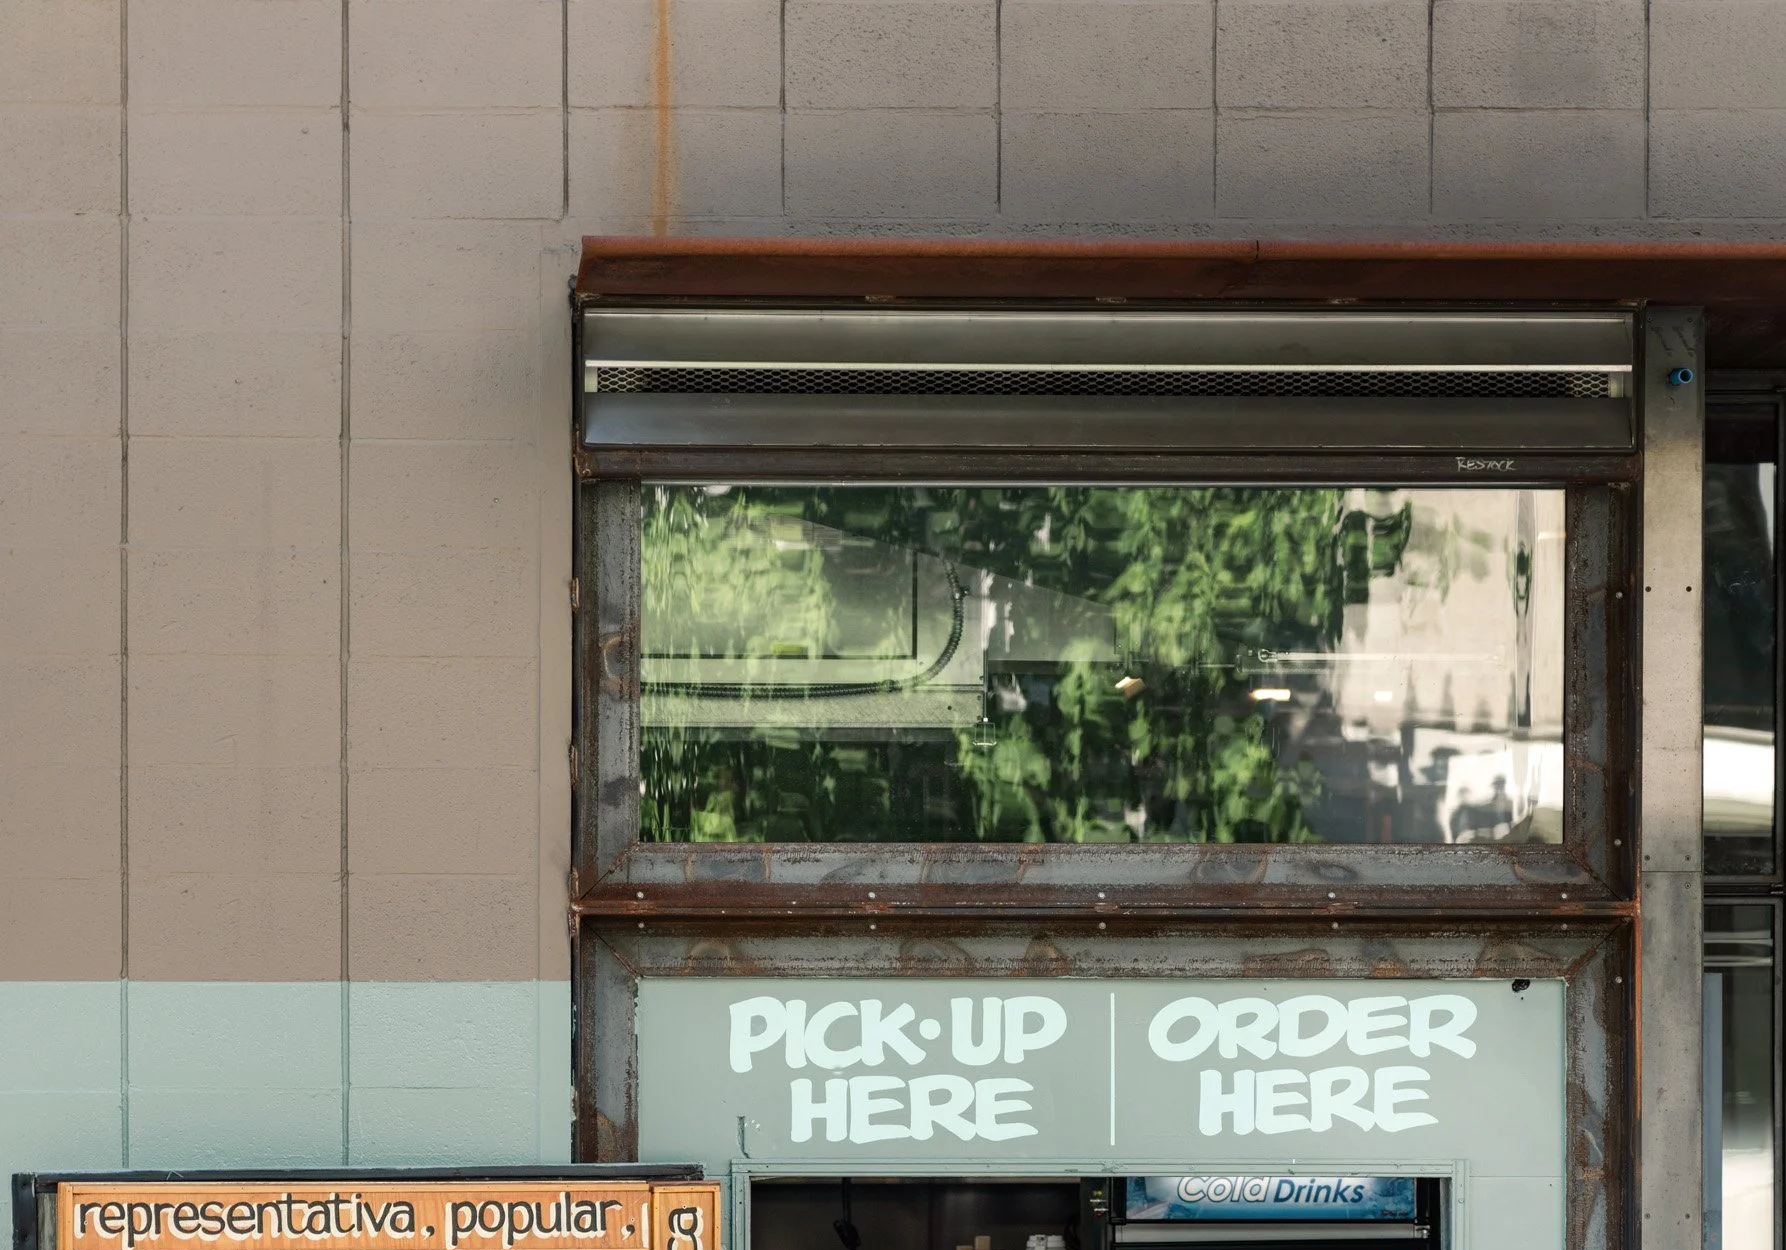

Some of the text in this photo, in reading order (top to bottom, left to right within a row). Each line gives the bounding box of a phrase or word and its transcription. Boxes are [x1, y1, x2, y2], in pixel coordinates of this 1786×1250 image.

[1148, 995, 1477, 1061] ORDER
[790, 1075, 1039, 1144] HERE
[1199, 1066, 1439, 1135] HERE
[1177, 1176, 1364, 1203] Cold Drinks
